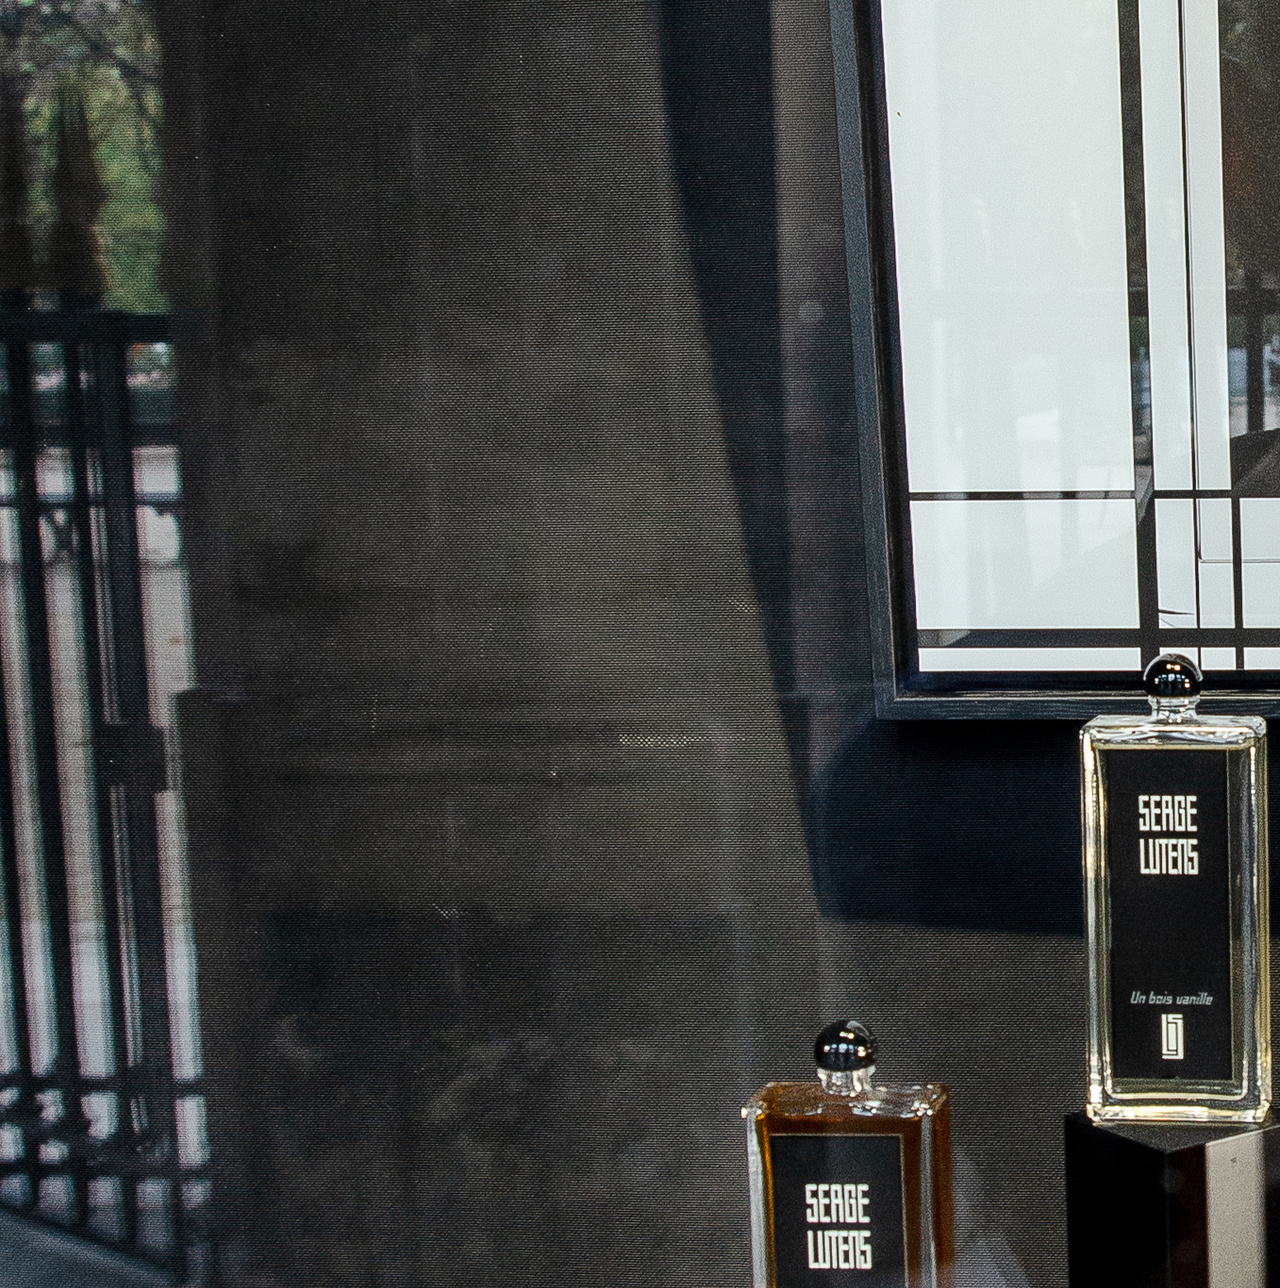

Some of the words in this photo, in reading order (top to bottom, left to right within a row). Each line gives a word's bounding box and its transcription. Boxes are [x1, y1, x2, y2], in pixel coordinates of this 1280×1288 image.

[1138, 795, 1198, 831] SERGE
[1139, 838, 1199, 875] LUTENS
[1130, 991, 1146, 1004] Un
[1148, 990, 1173, 1005] bois
[1176, 991, 1213, 1005] vanille
[805, 1183, 870, 1223] SERGE
[807, 1229, 872, 1270] LUTENS
